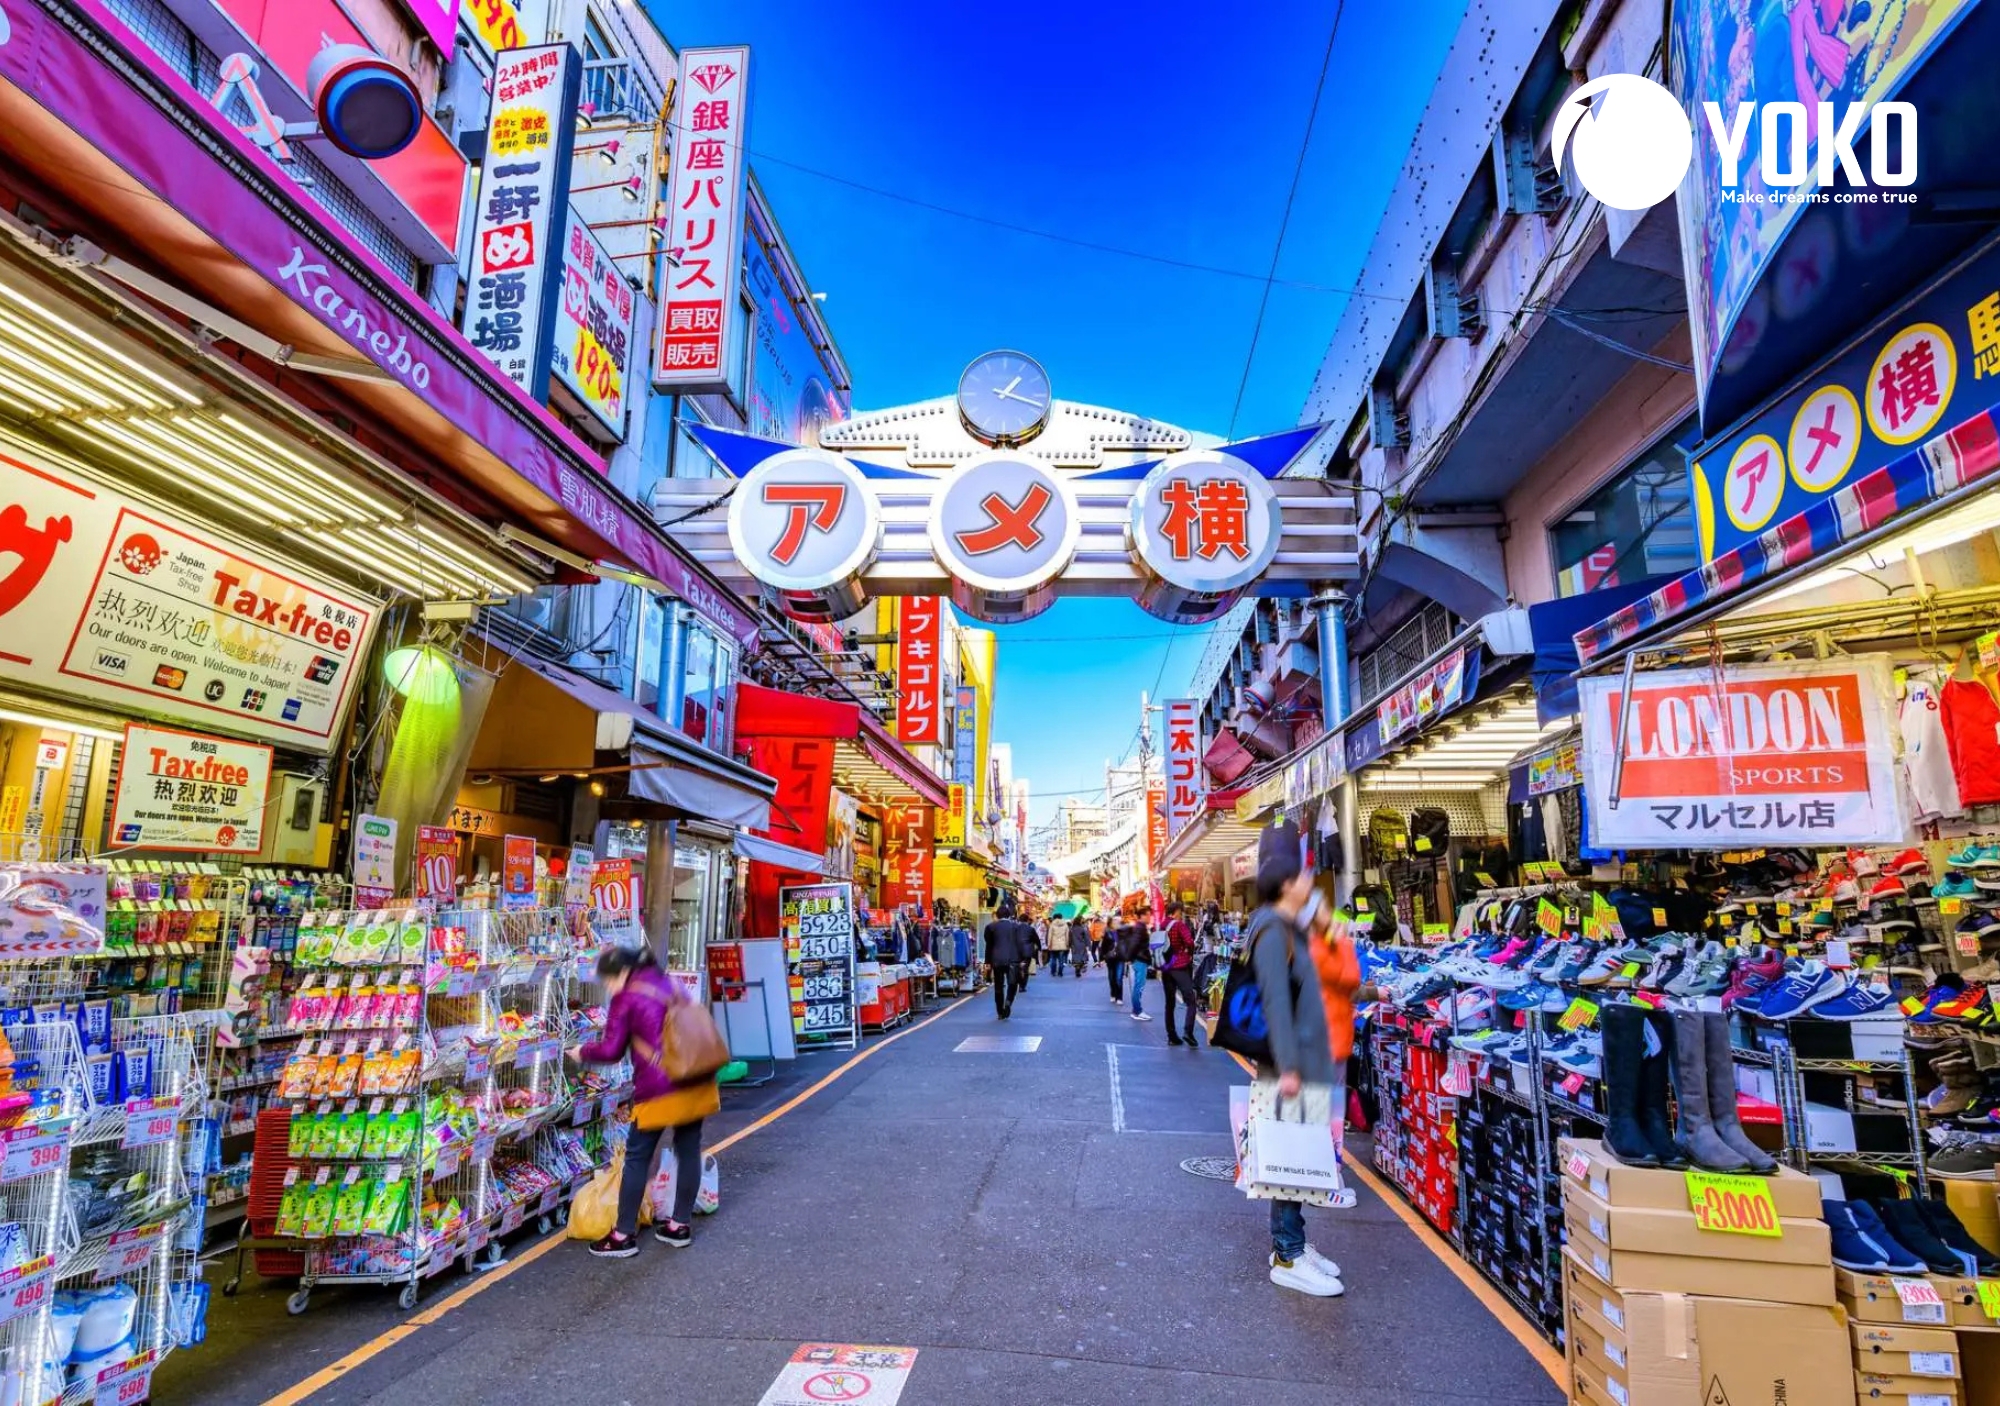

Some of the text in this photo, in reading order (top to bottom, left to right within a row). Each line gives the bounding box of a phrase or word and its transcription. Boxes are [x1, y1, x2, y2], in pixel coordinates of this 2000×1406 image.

[498, 50, 559, 84] 24時間
[670, 100, 730, 291] 銀座パリス
[278, 247, 431, 390] Kanebo
[669, 307, 718, 331] 買取
[665, 341, 716, 367] 販売
[1736, 339, 1940, 515] アメ横
[558, 468, 621, 542] 雪肌精
[763, 479, 1250, 566] アメ横
[170, 561, 204, 583] Tax-free
[176, 552, 207, 571] Japan.
[178, 577, 200, 594] Shop
[95, 588, 211, 648] 热烈欢迎
[214, 570, 351, 651] Tax-free
[89, 622, 291, 691] Our doors are open. Welcome to Japan!
[98, 653, 127, 671] VISA
[1624, 687, 1845, 759] LONDON
[149, 748, 249, 786] Tax-free
[1171, 705, 1198, 817] 二木ゴル
[1730, 765, 1845, 786] SPORTS
[154, 778, 239, 807] 热烈欢迎
[1650, 802, 1836, 830] マルセル店
[944, 836, 960, 844] 入口
[801, 914, 851, 934] 5923
[148, 1118, 172, 1136] 499
[31, 1145, 61, 1167] 398
[14, 1282, 45, 1308] 498
[119, 1376, 145, 1401] 598
